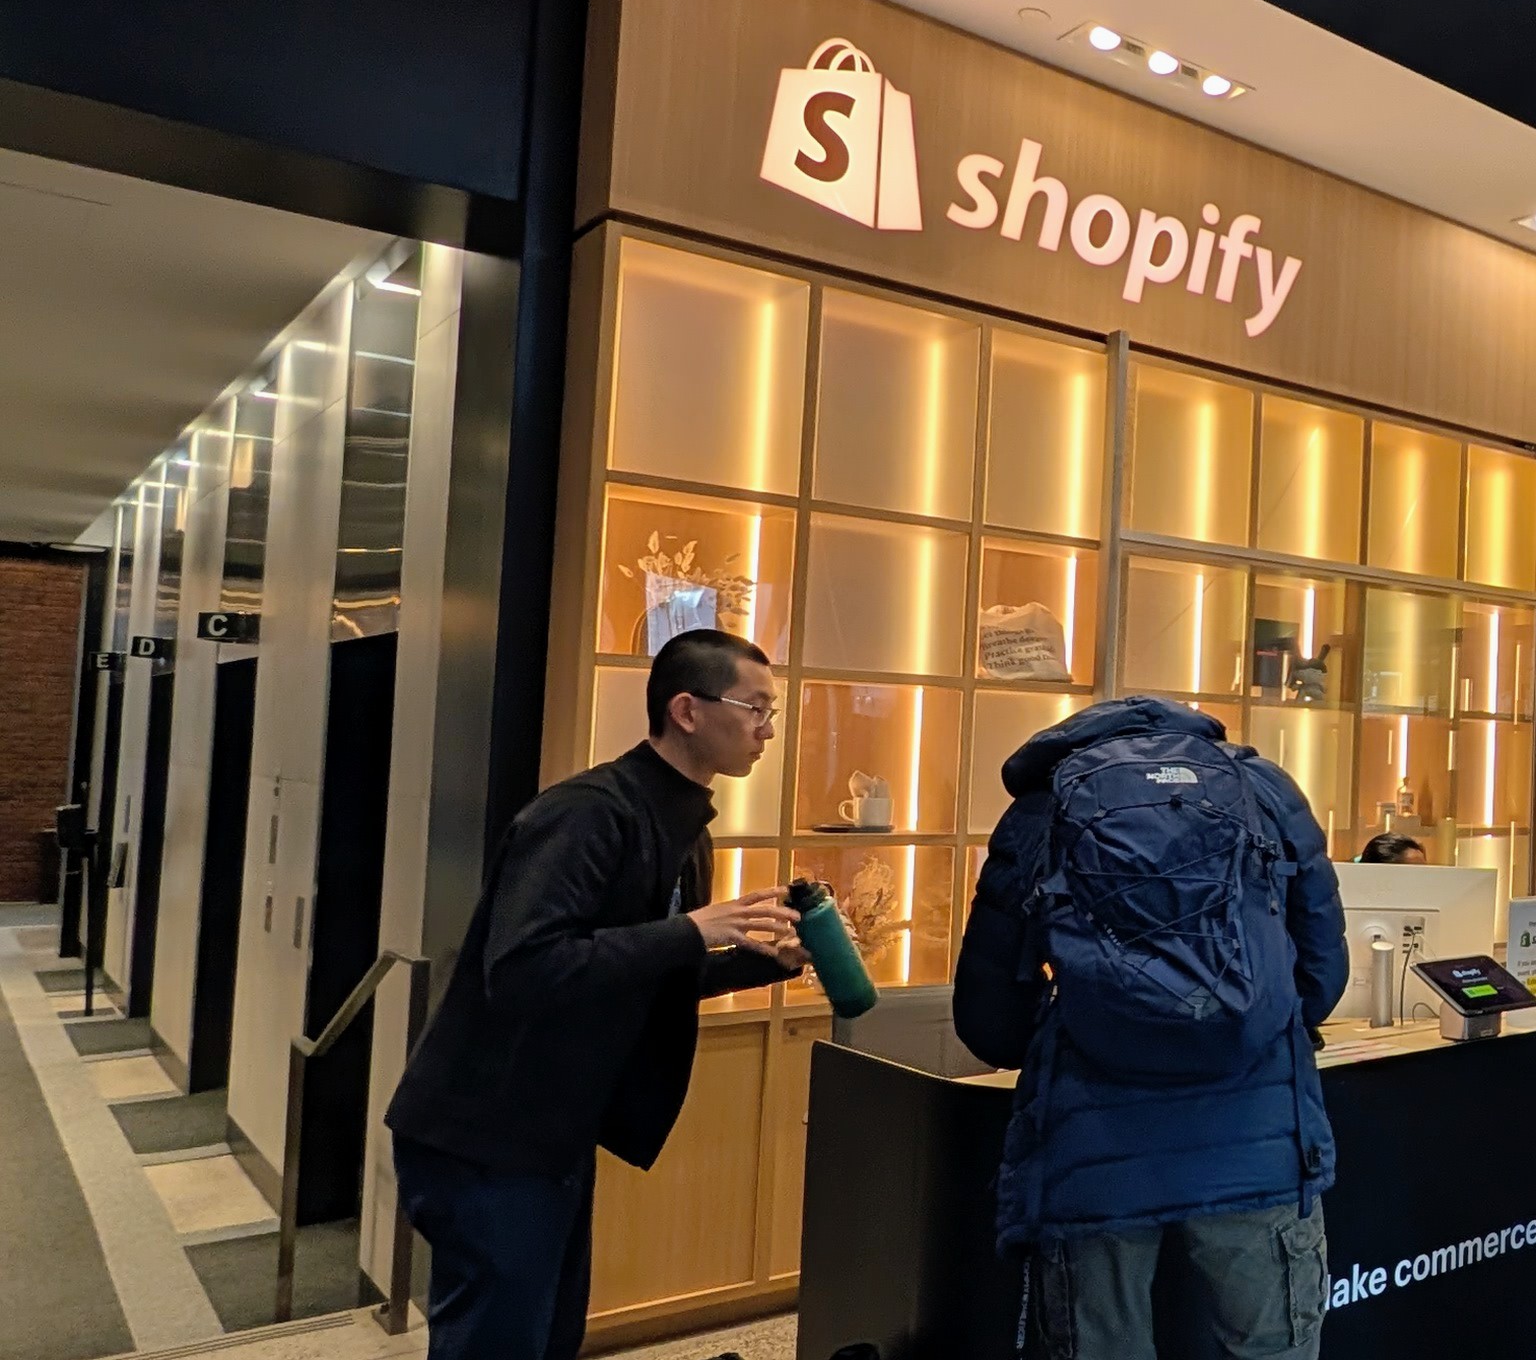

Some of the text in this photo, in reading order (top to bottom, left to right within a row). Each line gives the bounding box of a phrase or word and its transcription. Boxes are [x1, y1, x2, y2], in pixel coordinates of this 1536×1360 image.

[946, 137, 1302, 338] shopify
[208, 614, 228, 636] C
[138, 638, 156, 656] D
[96, 653, 109, 669] E
